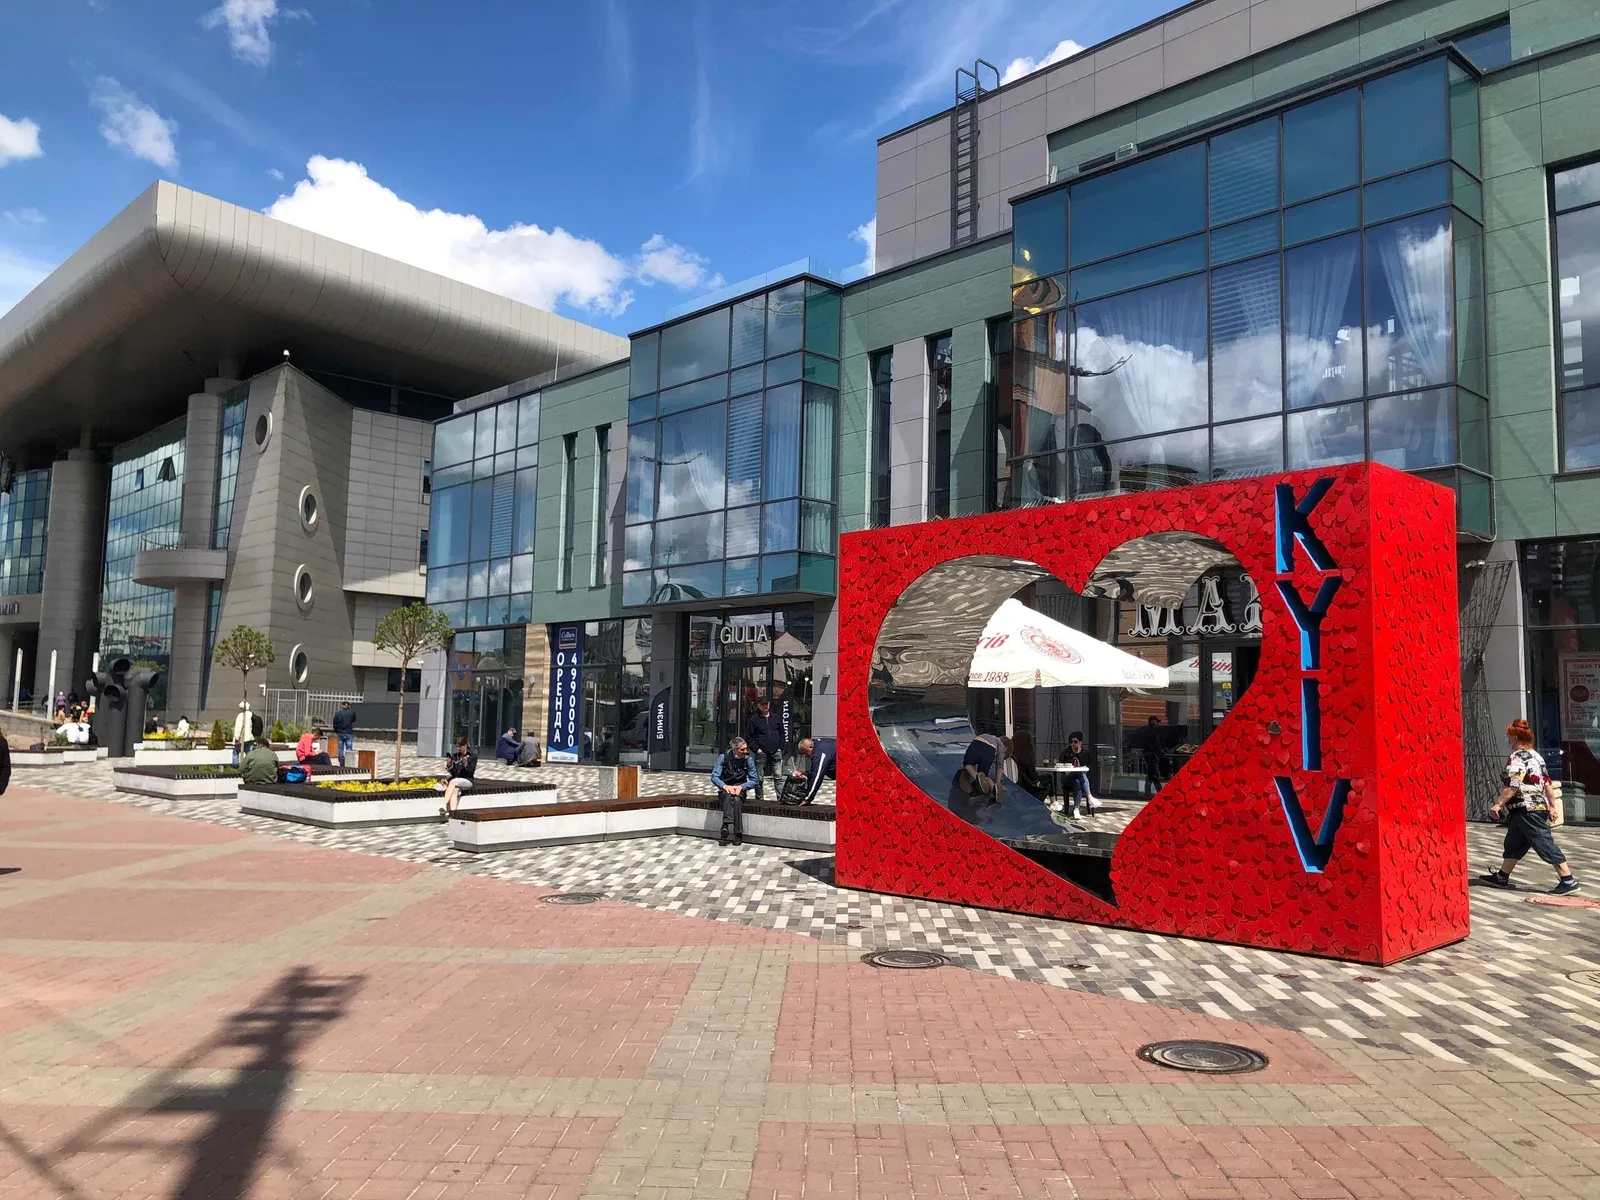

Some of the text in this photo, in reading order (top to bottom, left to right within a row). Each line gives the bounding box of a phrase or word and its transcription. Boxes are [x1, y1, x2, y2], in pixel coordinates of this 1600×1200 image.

[720, 624, 768, 644] GIULIA
[553, 651, 566, 743] ОРЕНДА
[567, 652, 577, 747] 4990000
[983, 671, 1009, 683] 1988
[1273, 477, 1351, 874] KYIV
[656, 702, 664, 740] БІЛИЗНА
